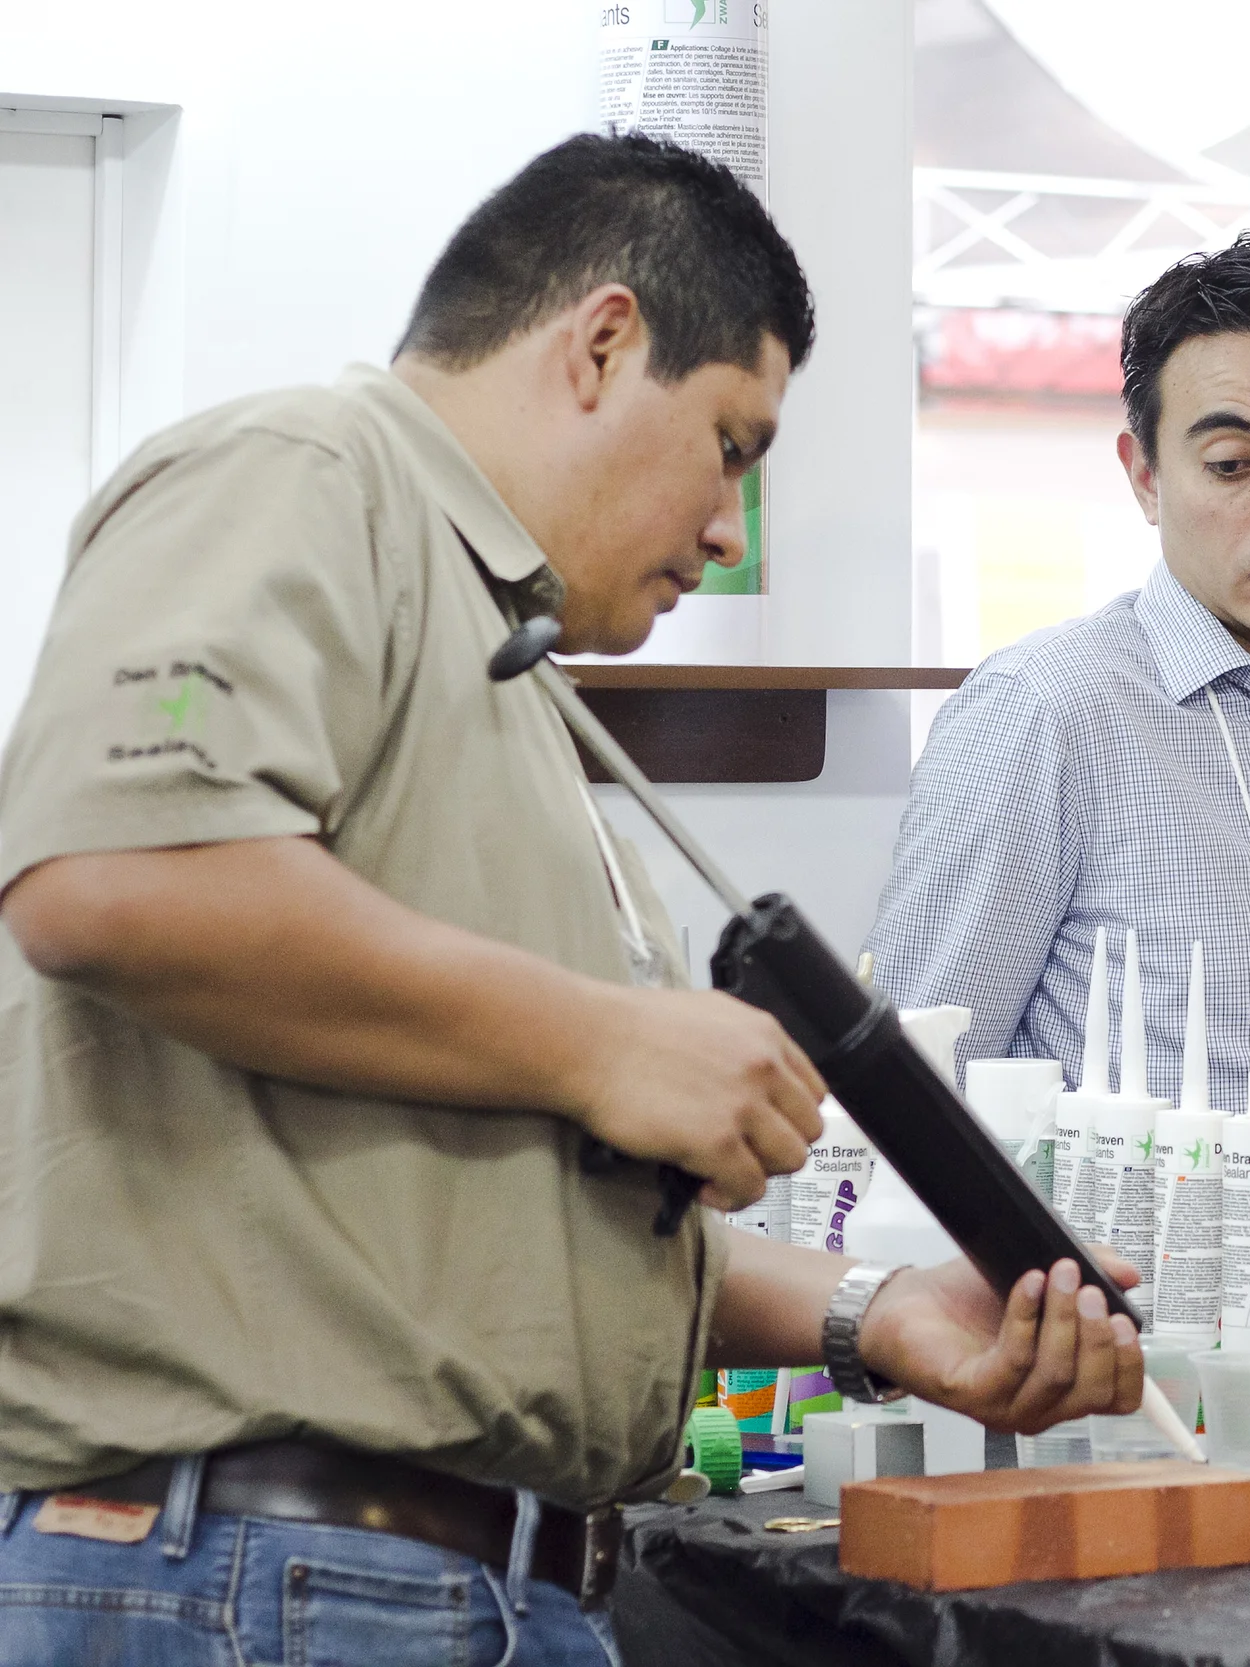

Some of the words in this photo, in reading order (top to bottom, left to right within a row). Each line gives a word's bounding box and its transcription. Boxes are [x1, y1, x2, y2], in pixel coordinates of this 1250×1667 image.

[711, 45, 731, 53] Collage
[1055, 1127, 1080, 1138] raven
[814, 1160, 862, 1172] Sealants
